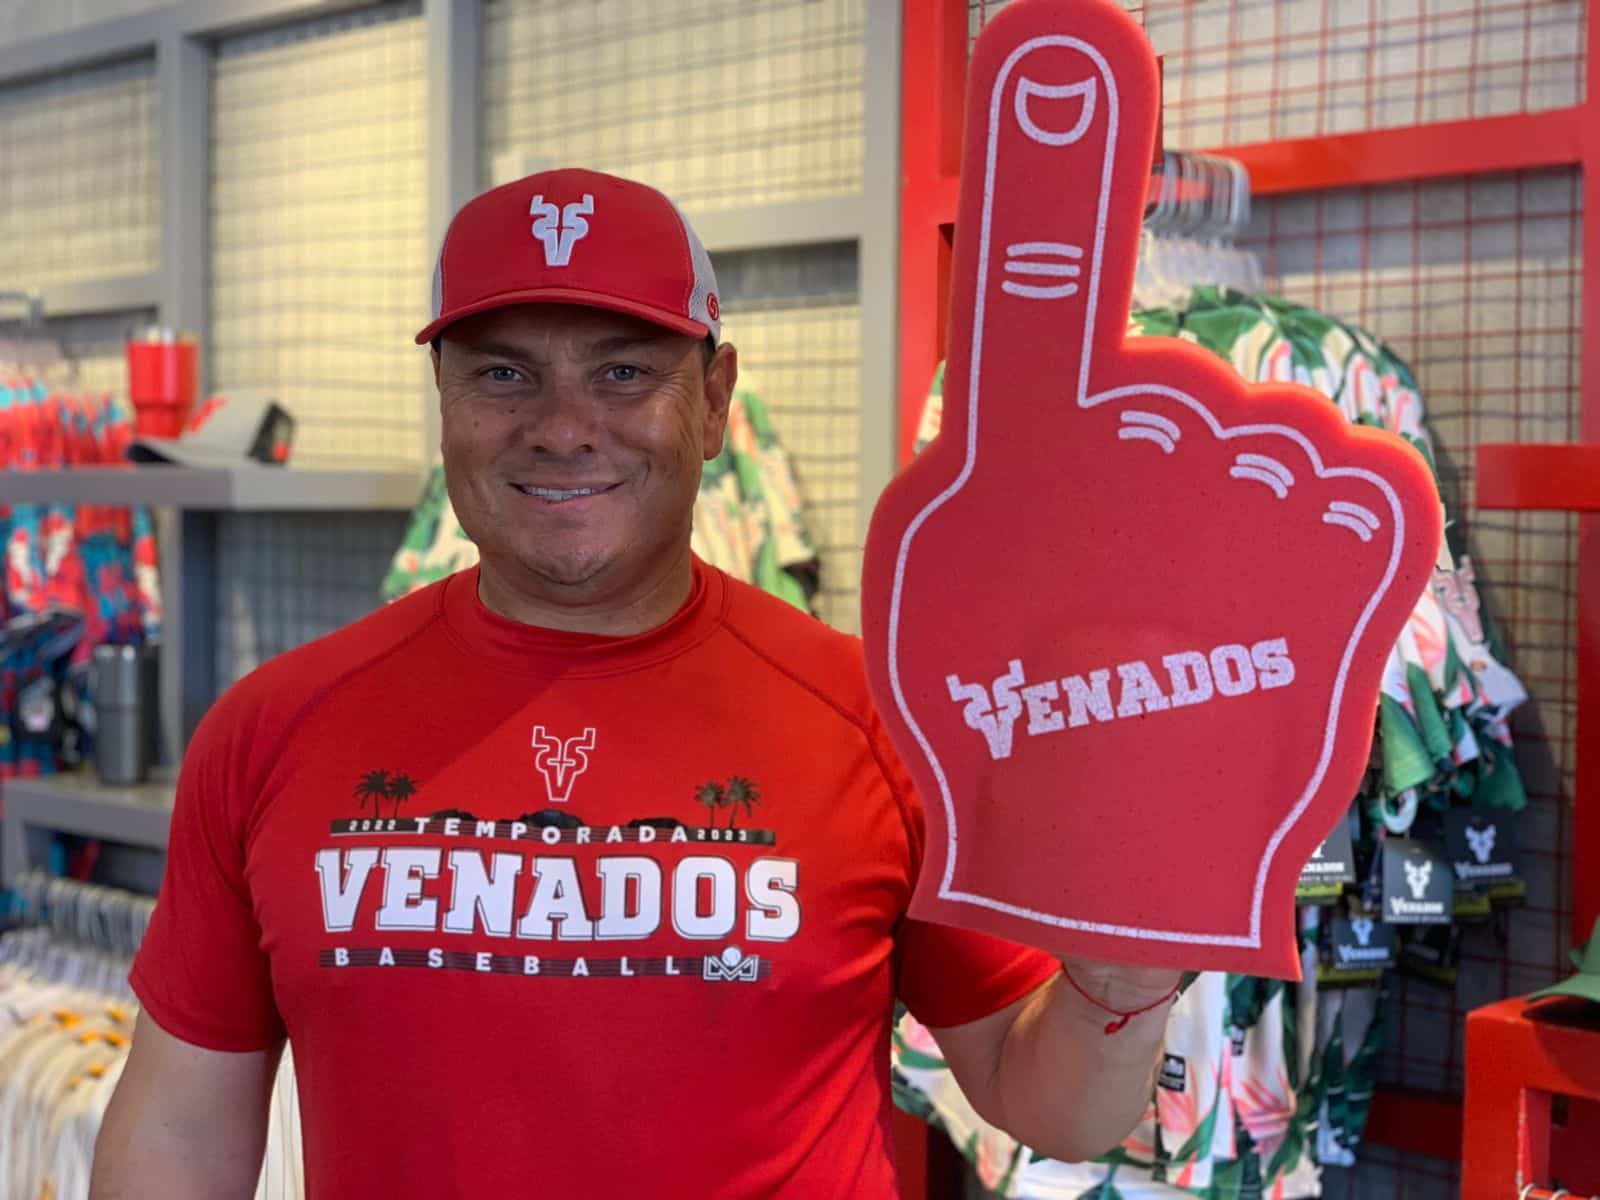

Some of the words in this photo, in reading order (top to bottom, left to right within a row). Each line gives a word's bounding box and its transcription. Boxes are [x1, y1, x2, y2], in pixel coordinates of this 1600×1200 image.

[946, 637, 1296, 761] VENADOS
[348, 818, 398, 832] 2022
[414, 817, 689, 845] TEMPORADA
[696, 827, 748, 842] 2023
[314, 846, 802, 942] VENADOS
[334, 947, 681, 977] BASEBALL
